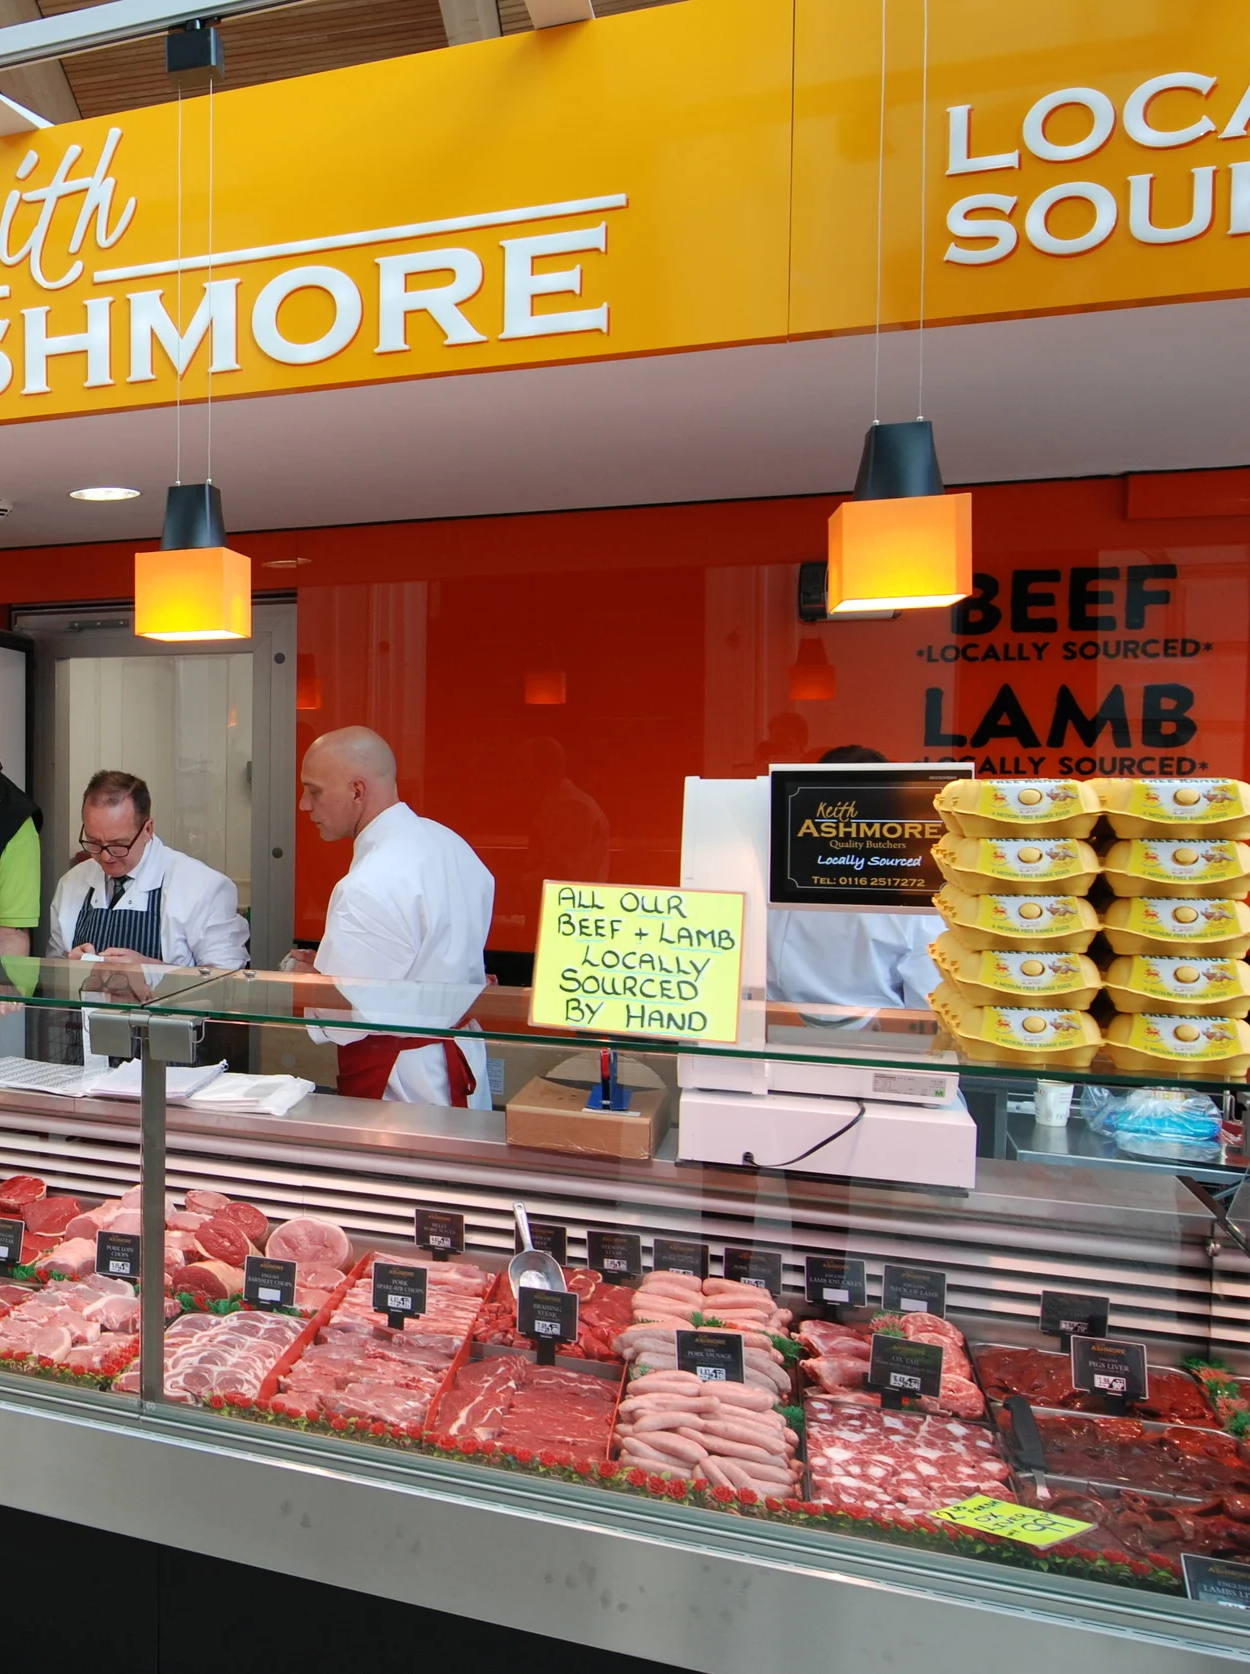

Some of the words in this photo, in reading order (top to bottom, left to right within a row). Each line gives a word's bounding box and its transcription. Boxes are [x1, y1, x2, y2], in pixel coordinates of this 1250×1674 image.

[951, 564, 1178, 635] BEEF
[924, 683, 1198, 749] LAMB
[816, 800, 859, 823] Keith
[797, 819, 942, 839] ASHMORE
[829, 840, 863, 850] Quality
[866, 840, 906, 849] Butchers
[817, 855, 865, 870] Locally
[867, 856, 922, 867] Sourced
[812, 876, 836, 885] TEL:
[839, 876, 870, 886] 0116
[870, 878, 926, 887] 2517272
[558, 887, 605, 910] ALL
[620, 892, 687, 919] OUR
[558, 913, 622, 940] BEEF
[634, 927, 649, 941] +
[659, 923, 735, 950] LAMB
[582, 945, 711, 982] LOCALLY
[559, 968, 698, 1001] SOURCED
[565, 998, 604, 1024] BY
[626, 1004, 707, 1032] HAND
[974, 1511, 1003, 1523] OX
